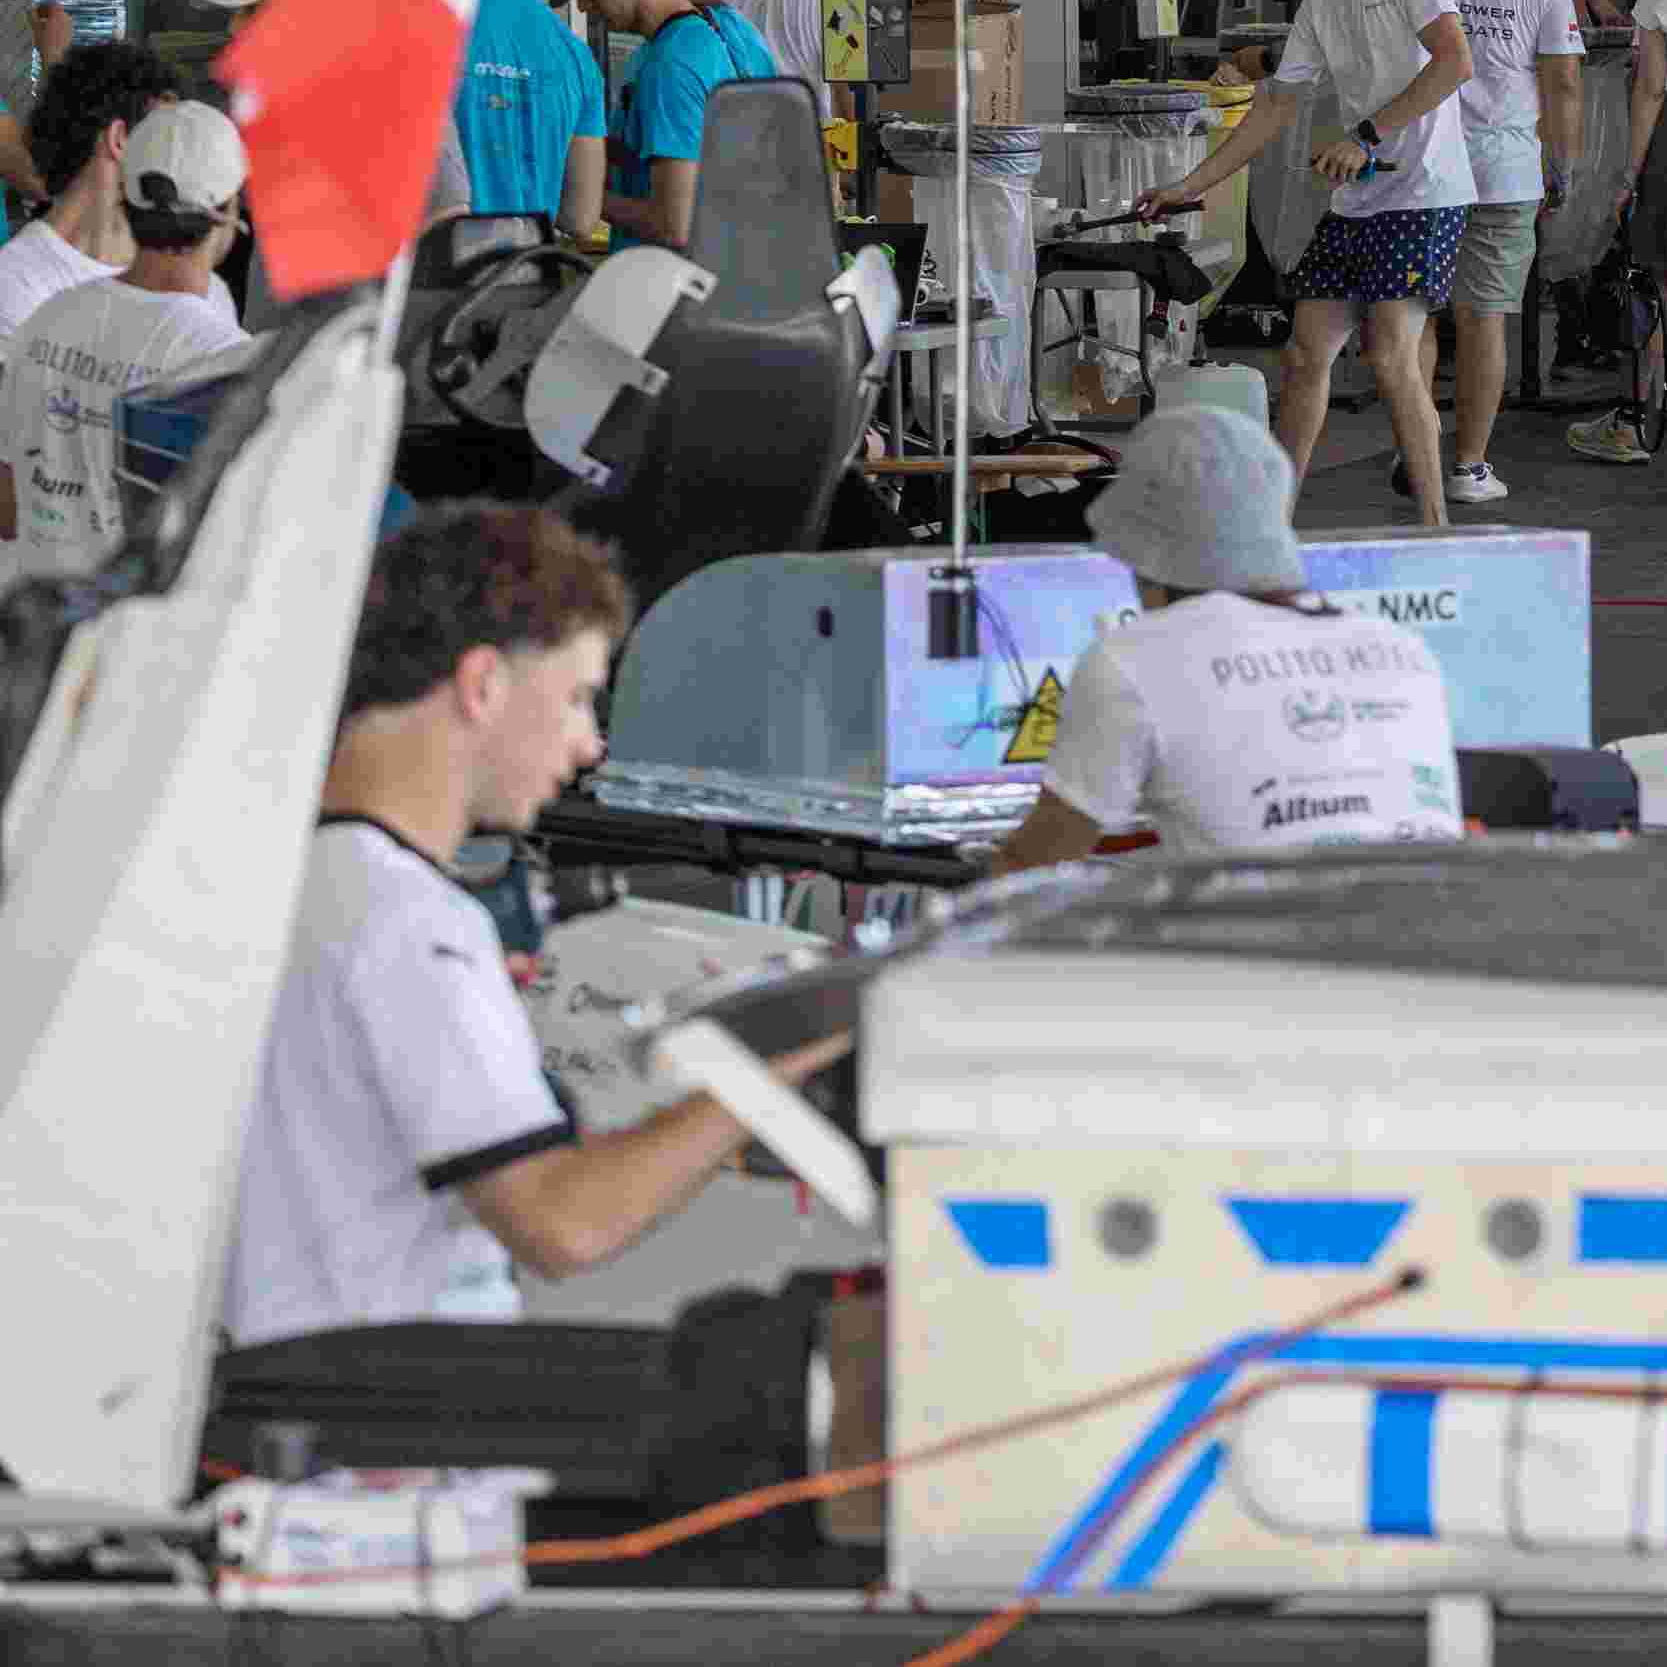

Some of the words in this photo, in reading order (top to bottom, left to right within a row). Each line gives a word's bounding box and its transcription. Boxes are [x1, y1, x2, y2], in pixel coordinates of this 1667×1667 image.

[1457, 3, 1516, 21] OWER
[1378, 588, 1459, 623] NMC
[1261, 794, 1373, 831] Altium
